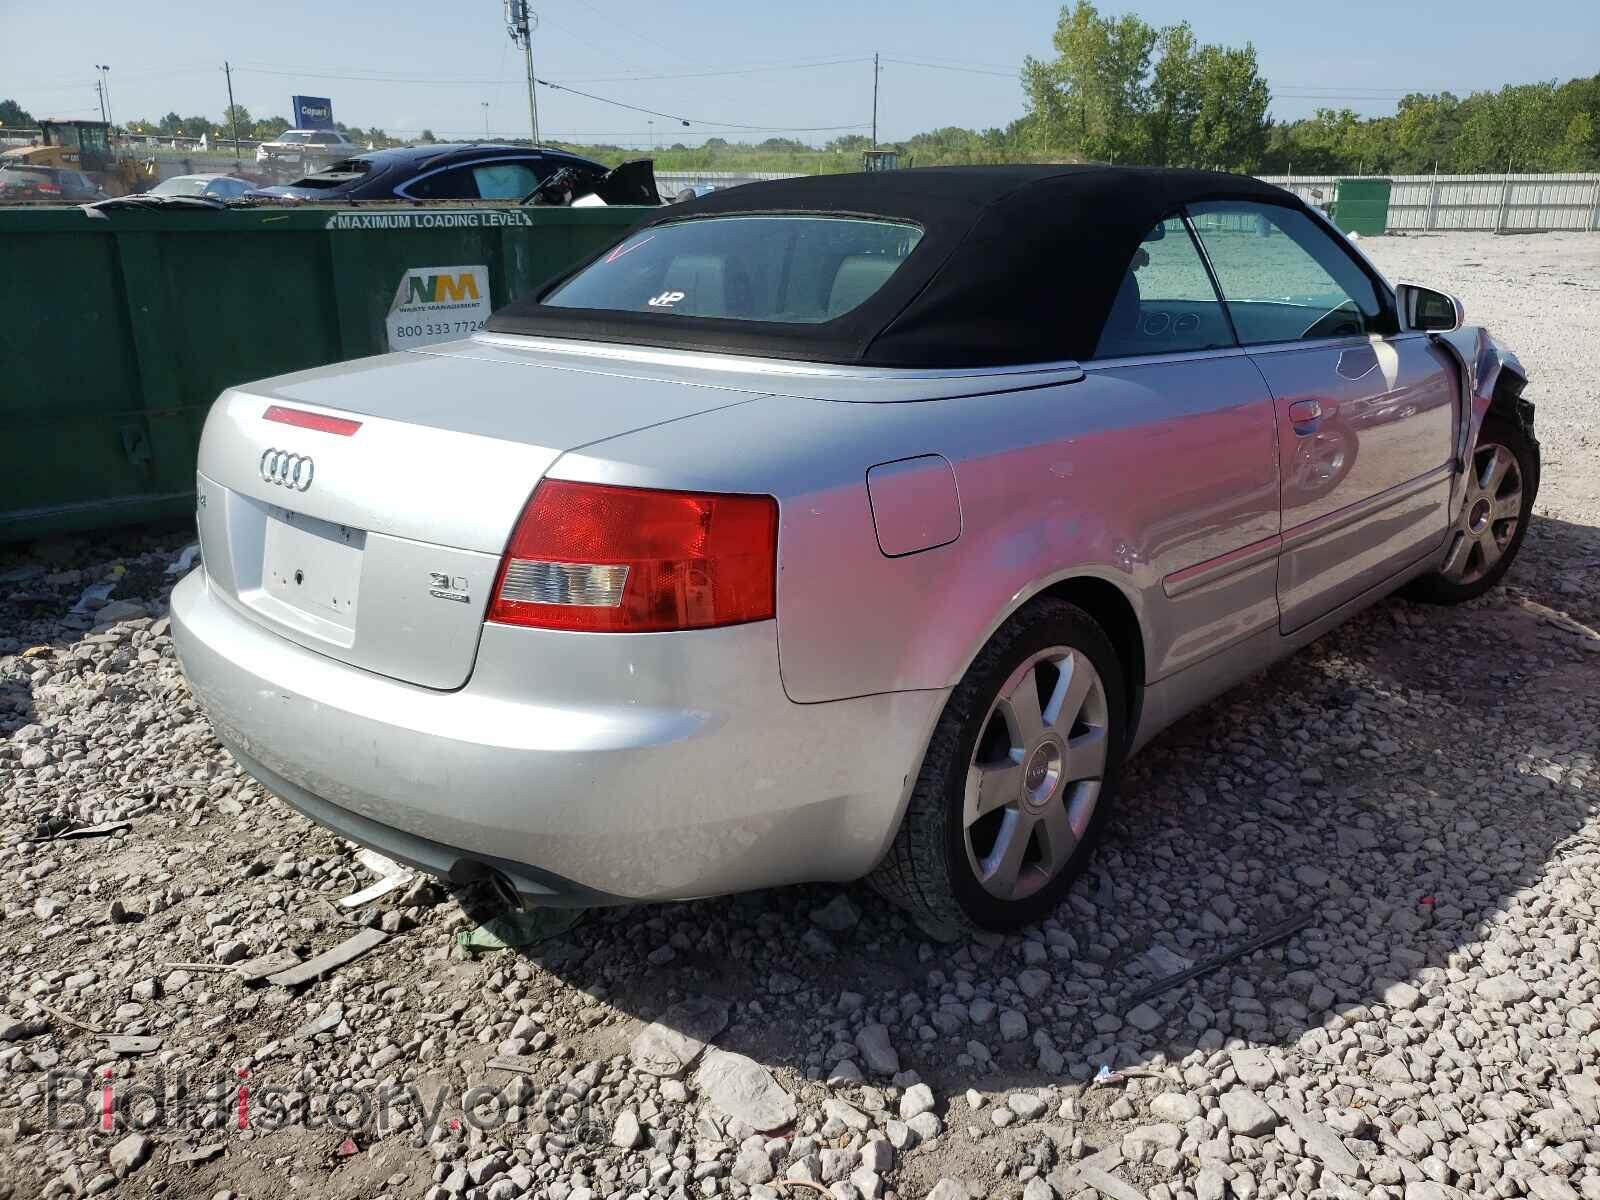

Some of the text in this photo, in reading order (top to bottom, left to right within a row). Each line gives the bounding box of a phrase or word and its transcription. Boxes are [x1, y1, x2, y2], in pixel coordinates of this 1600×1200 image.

[338, 213, 522, 229] MAXIMUM LOADING LEVEL
[428, 303, 481, 312] MANAGEMENT
[397, 326, 422, 338] 800
[427, 323, 450, 336] 333
